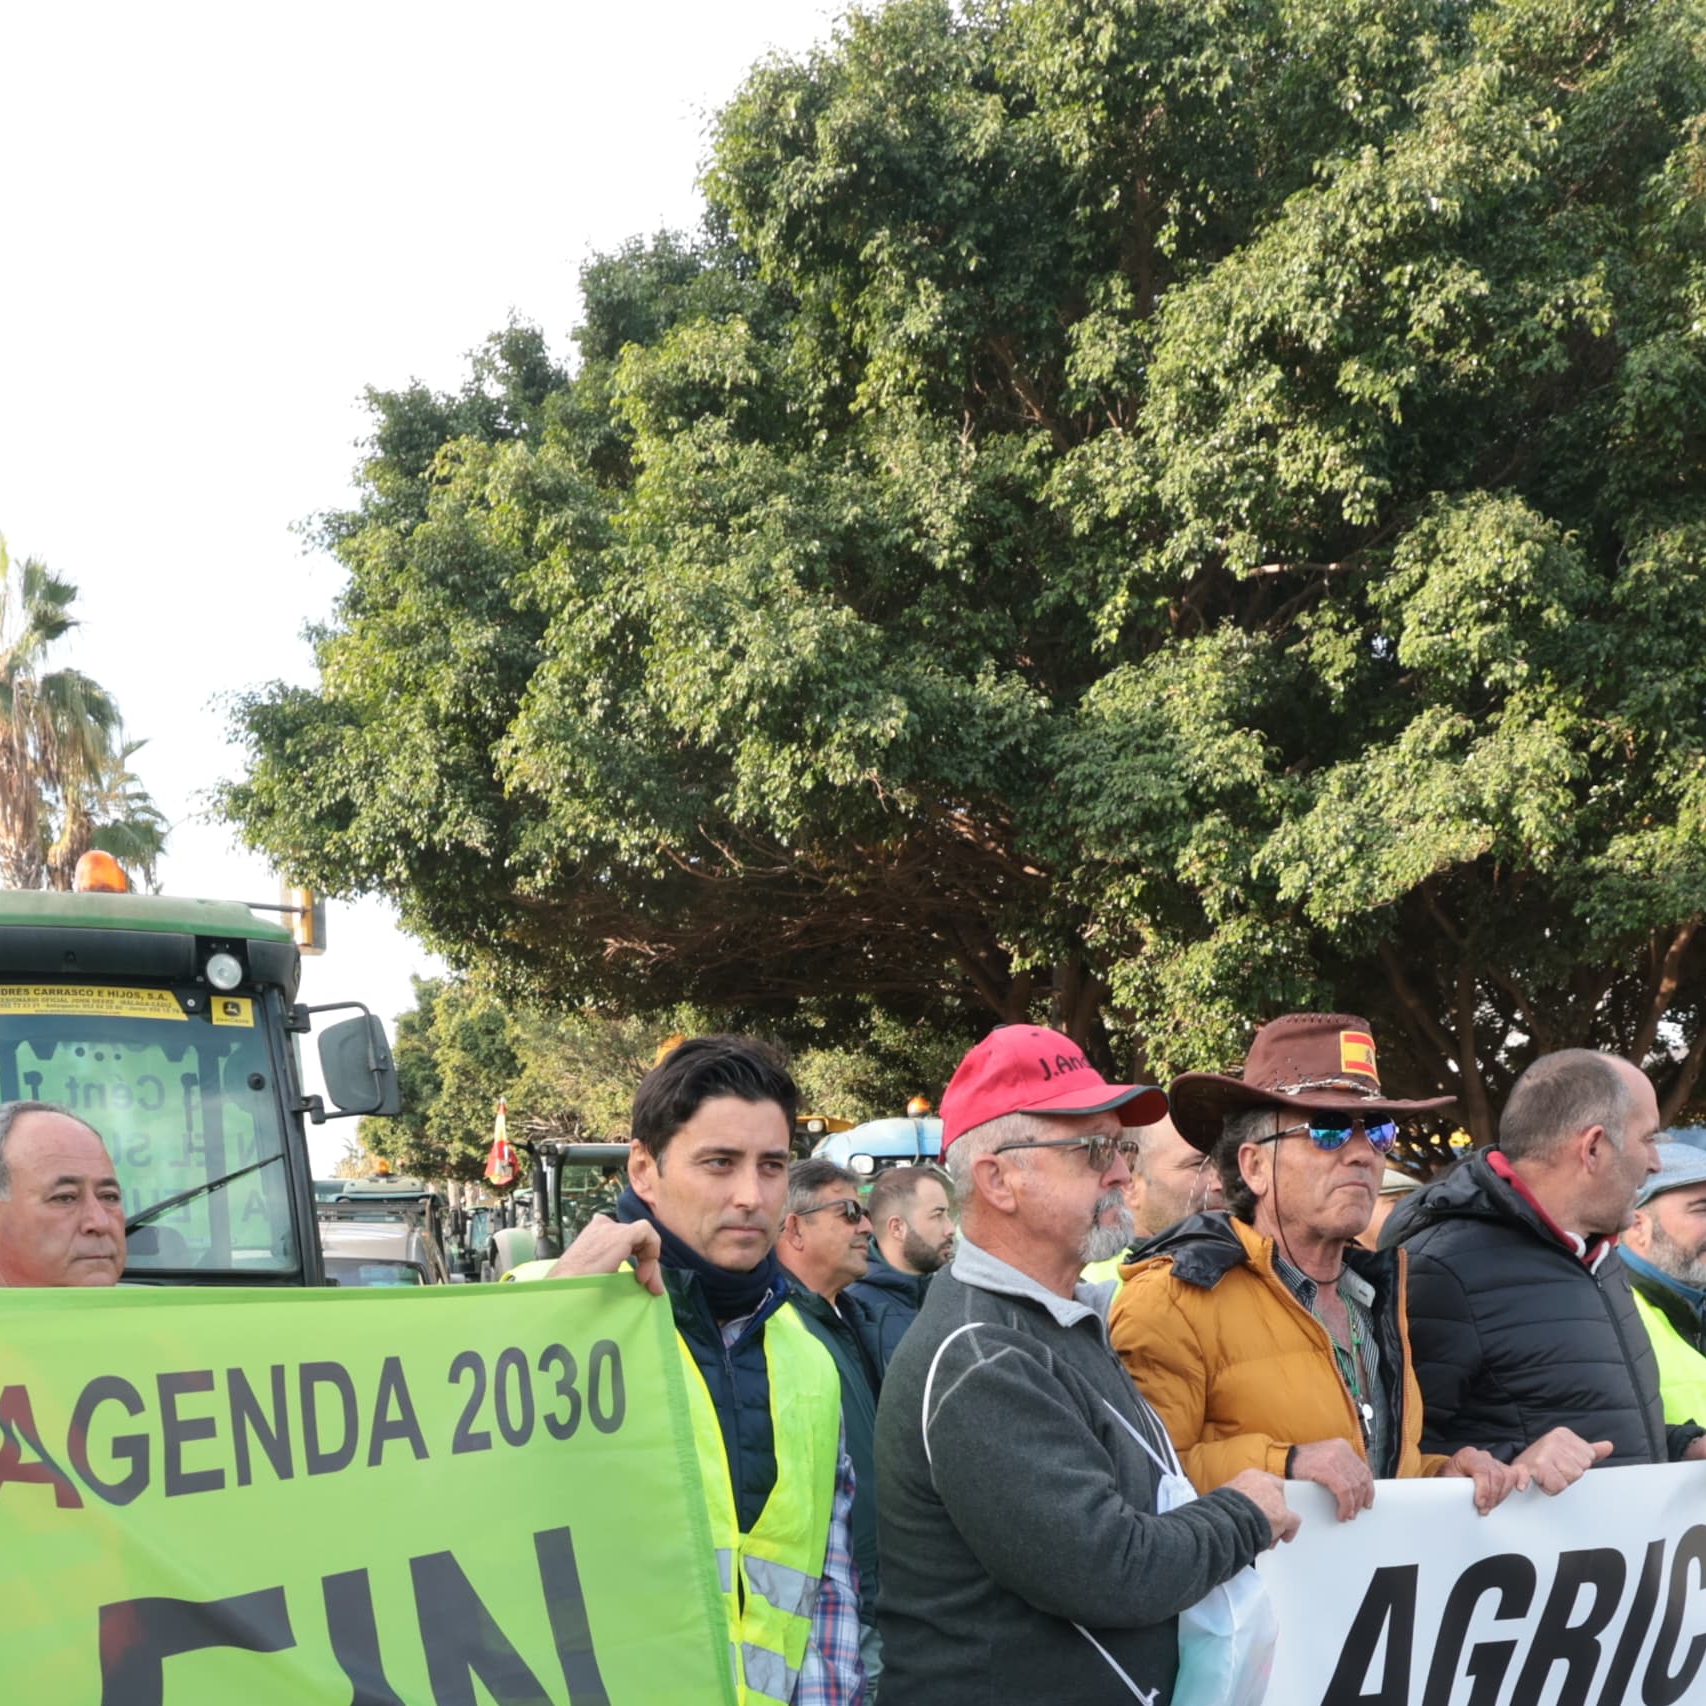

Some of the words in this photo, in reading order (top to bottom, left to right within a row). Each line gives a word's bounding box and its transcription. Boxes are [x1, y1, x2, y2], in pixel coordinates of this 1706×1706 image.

[33, 987, 94, 997] CARRASCO
[97, 989, 104, 997] E
[446, 1338, 628, 1456] 2030
